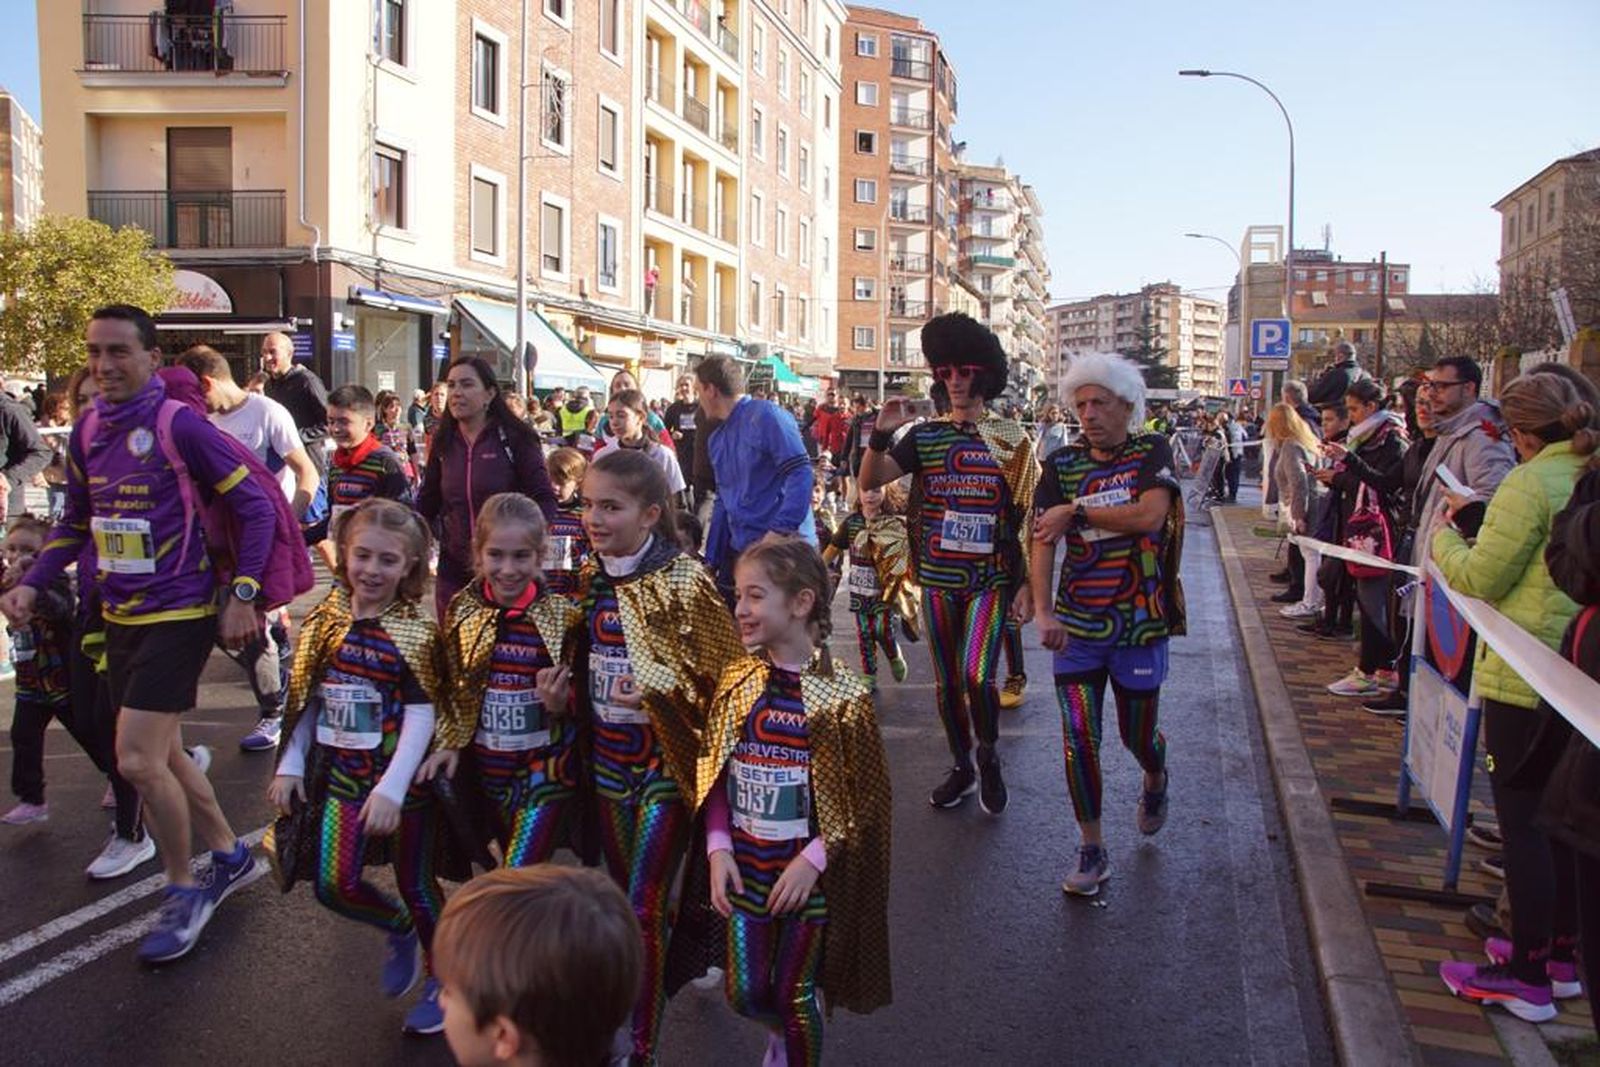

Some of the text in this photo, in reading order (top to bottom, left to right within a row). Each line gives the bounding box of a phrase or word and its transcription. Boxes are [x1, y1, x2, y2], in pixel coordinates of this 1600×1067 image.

[1259, 324, 1283, 353] P
[951, 521, 982, 541] 4571
[486, 690, 543, 704] SETEL
[481, 703, 527, 731] 6136
[740, 766, 799, 783] SETEL
[736, 781, 780, 815] 6137
